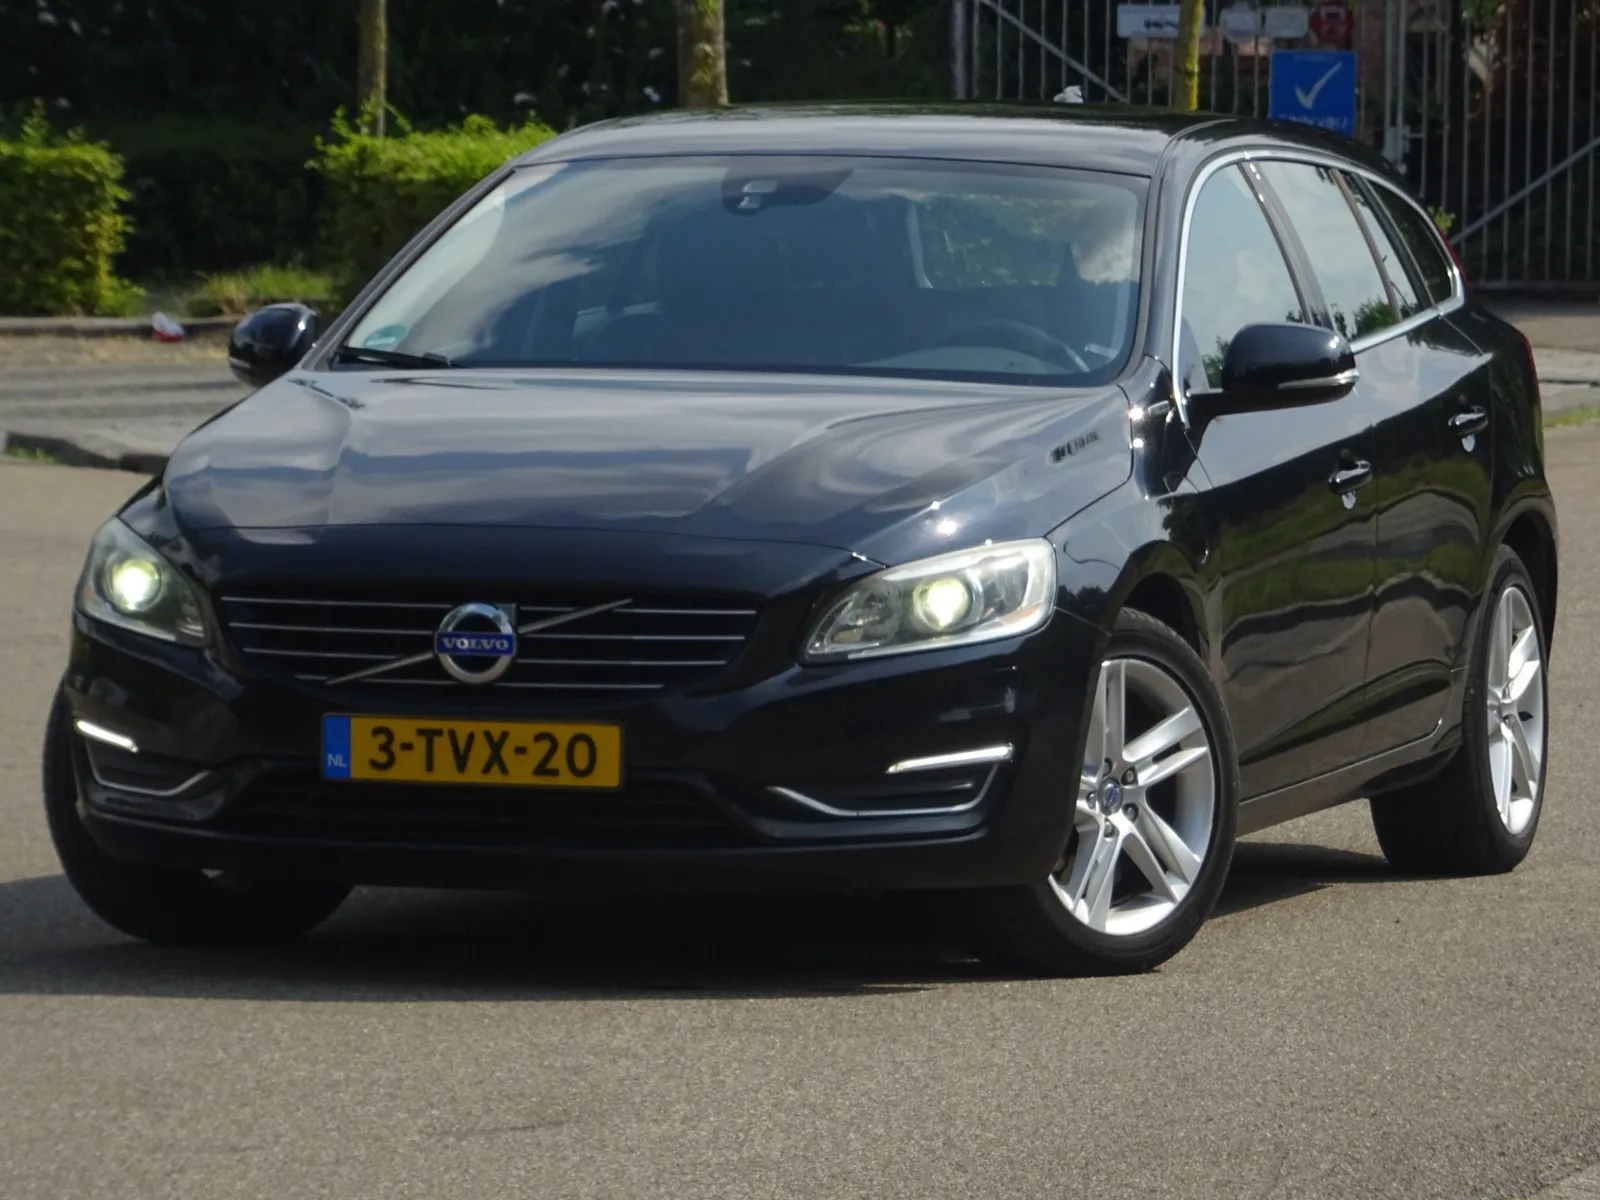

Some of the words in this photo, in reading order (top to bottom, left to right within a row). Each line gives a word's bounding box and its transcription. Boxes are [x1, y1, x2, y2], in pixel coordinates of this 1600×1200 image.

[441, 636, 510, 650] VOLVO
[368, 725, 598, 778] 3-TVX-20
[326, 753, 347, 768] NL
